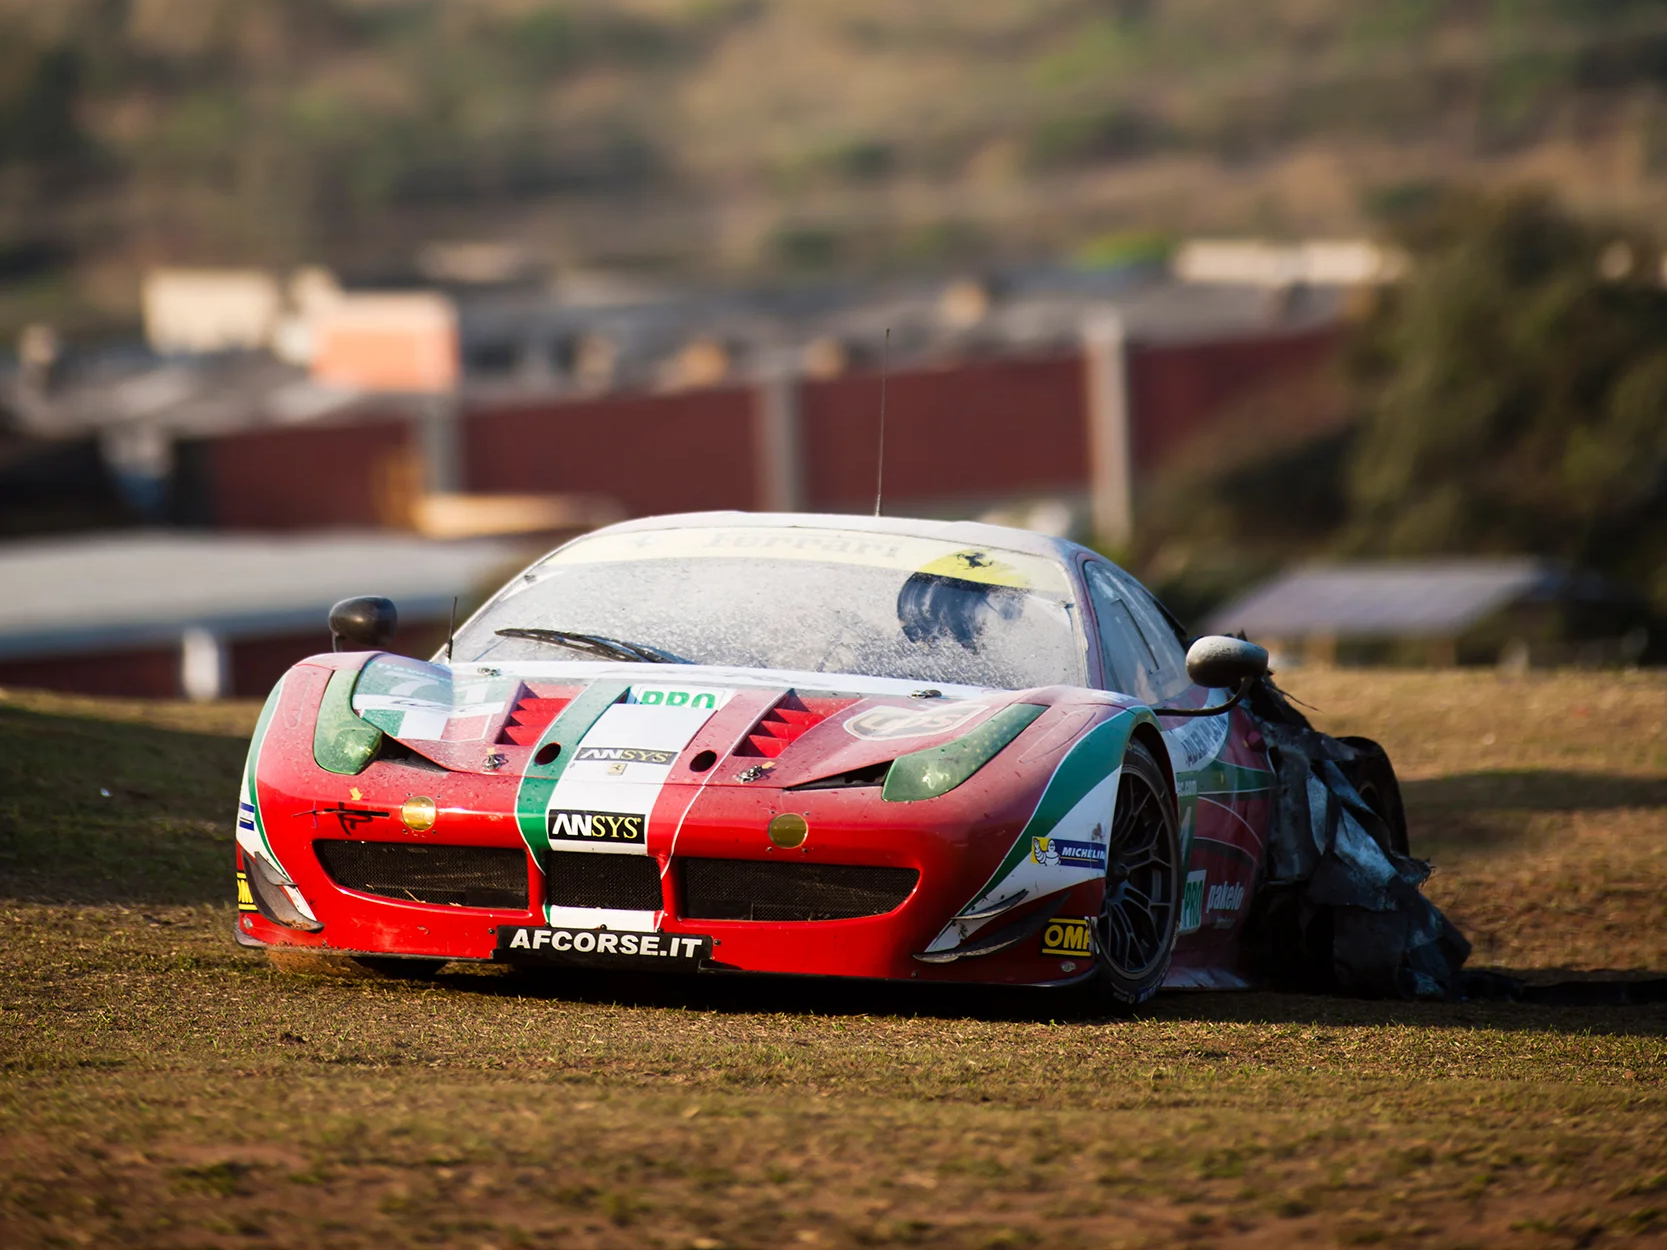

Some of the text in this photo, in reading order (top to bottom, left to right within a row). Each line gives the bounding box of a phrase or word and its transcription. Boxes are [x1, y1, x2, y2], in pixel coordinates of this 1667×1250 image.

[579, 748, 669, 763] ANSYS
[551, 813, 641, 839] ANSYS
[1206, 880, 1244, 914] pakelo
[509, 928, 702, 958] AFCORSE.IT
